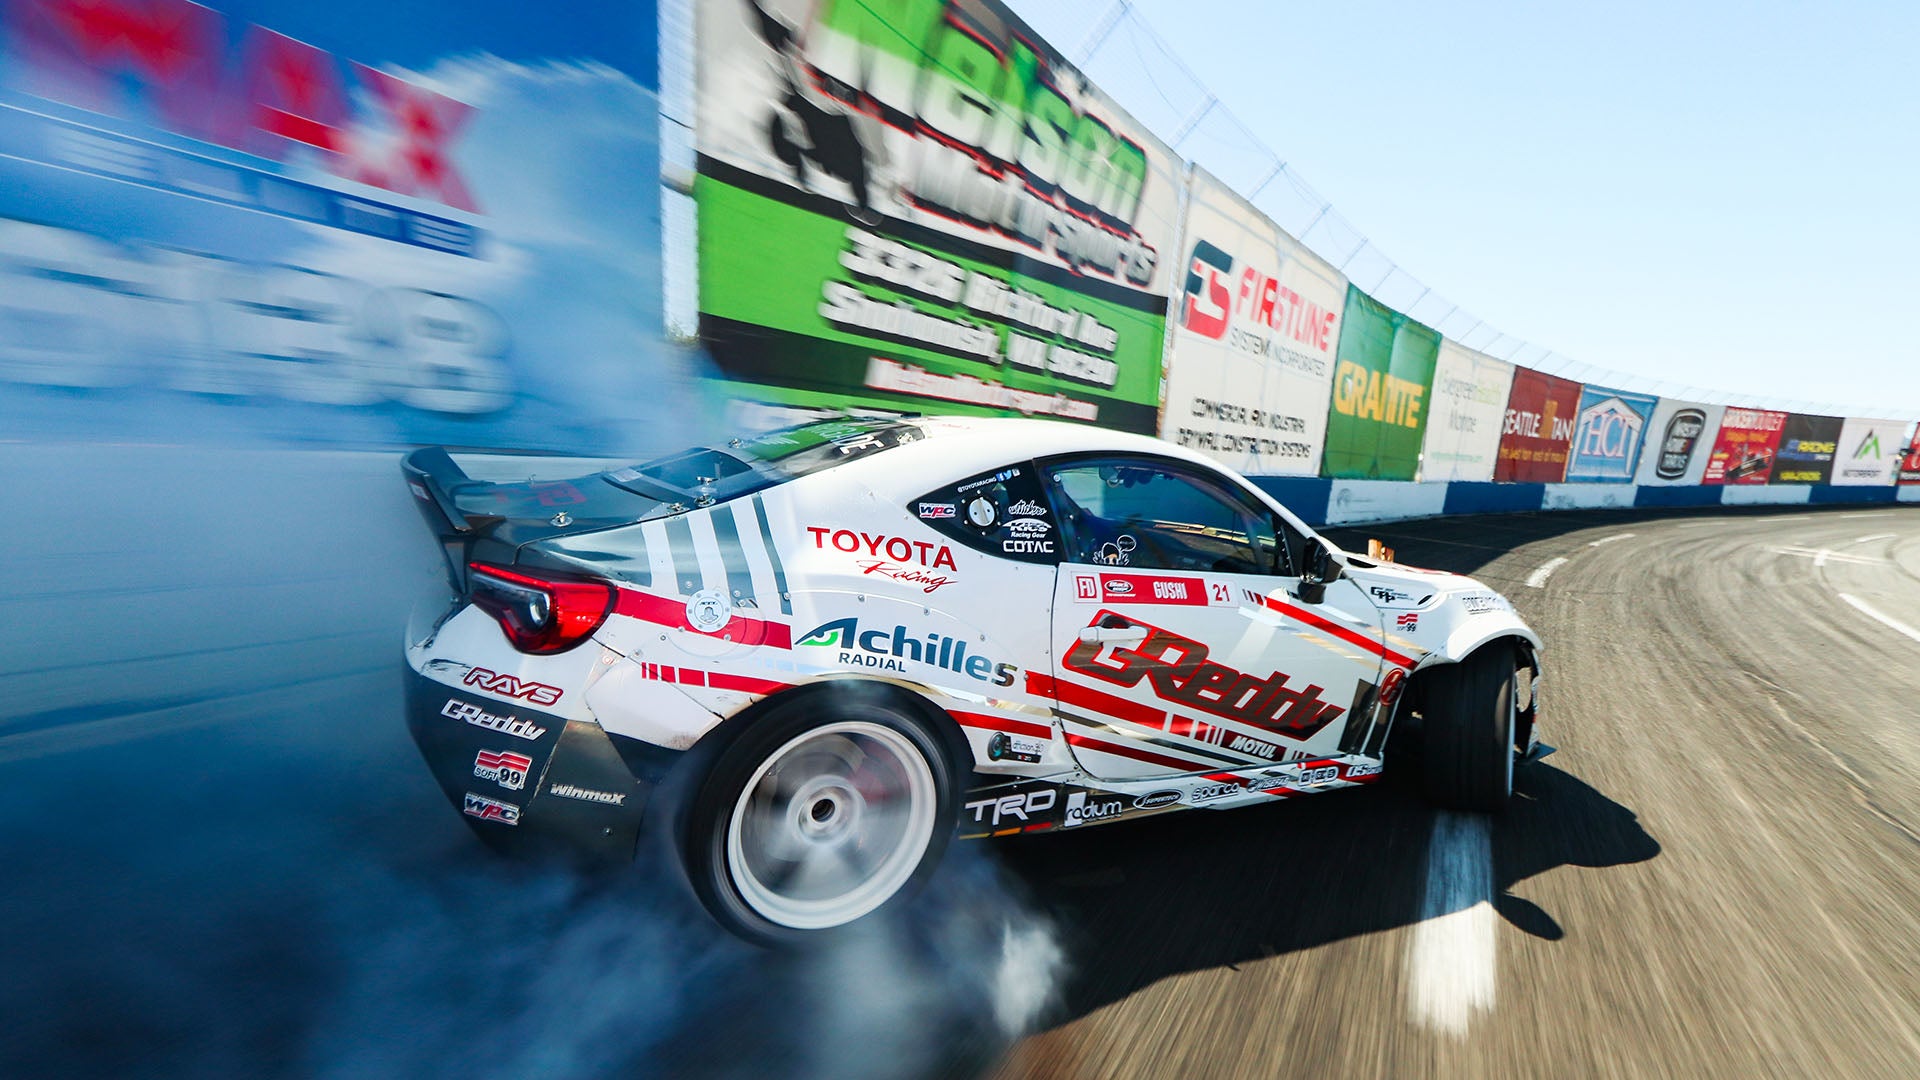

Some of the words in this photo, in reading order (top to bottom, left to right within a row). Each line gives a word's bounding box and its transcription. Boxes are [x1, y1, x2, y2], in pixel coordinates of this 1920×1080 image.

[1236, 266, 1336, 352] FIRSTLINE
[1334, 360, 1424, 429] GRANITE
[1502, 409, 1541, 438] SEATTLE
[1552, 416, 1574, 440] TAN
[807, 527, 958, 572] TOYOTA
[1003, 540, 1054, 553] COTAC
[1011, 531, 1031, 539] Racing
[856, 560, 959, 593] Racing
[1153, 581, 1188, 600] GUSHI
[1213, 584, 1230, 602] 21
[794, 618, 1018, 687] Achilles
[839, 652, 907, 673] RADIAL
[463, 666, 564, 706] RAYS
[1062, 608, 1347, 742] GReddy
[441, 699, 546, 741] GReddy
[1229, 736, 1278, 759] MOTUL
[965, 789, 1057, 826] TRD
[1192, 783, 1239, 800] sparco
